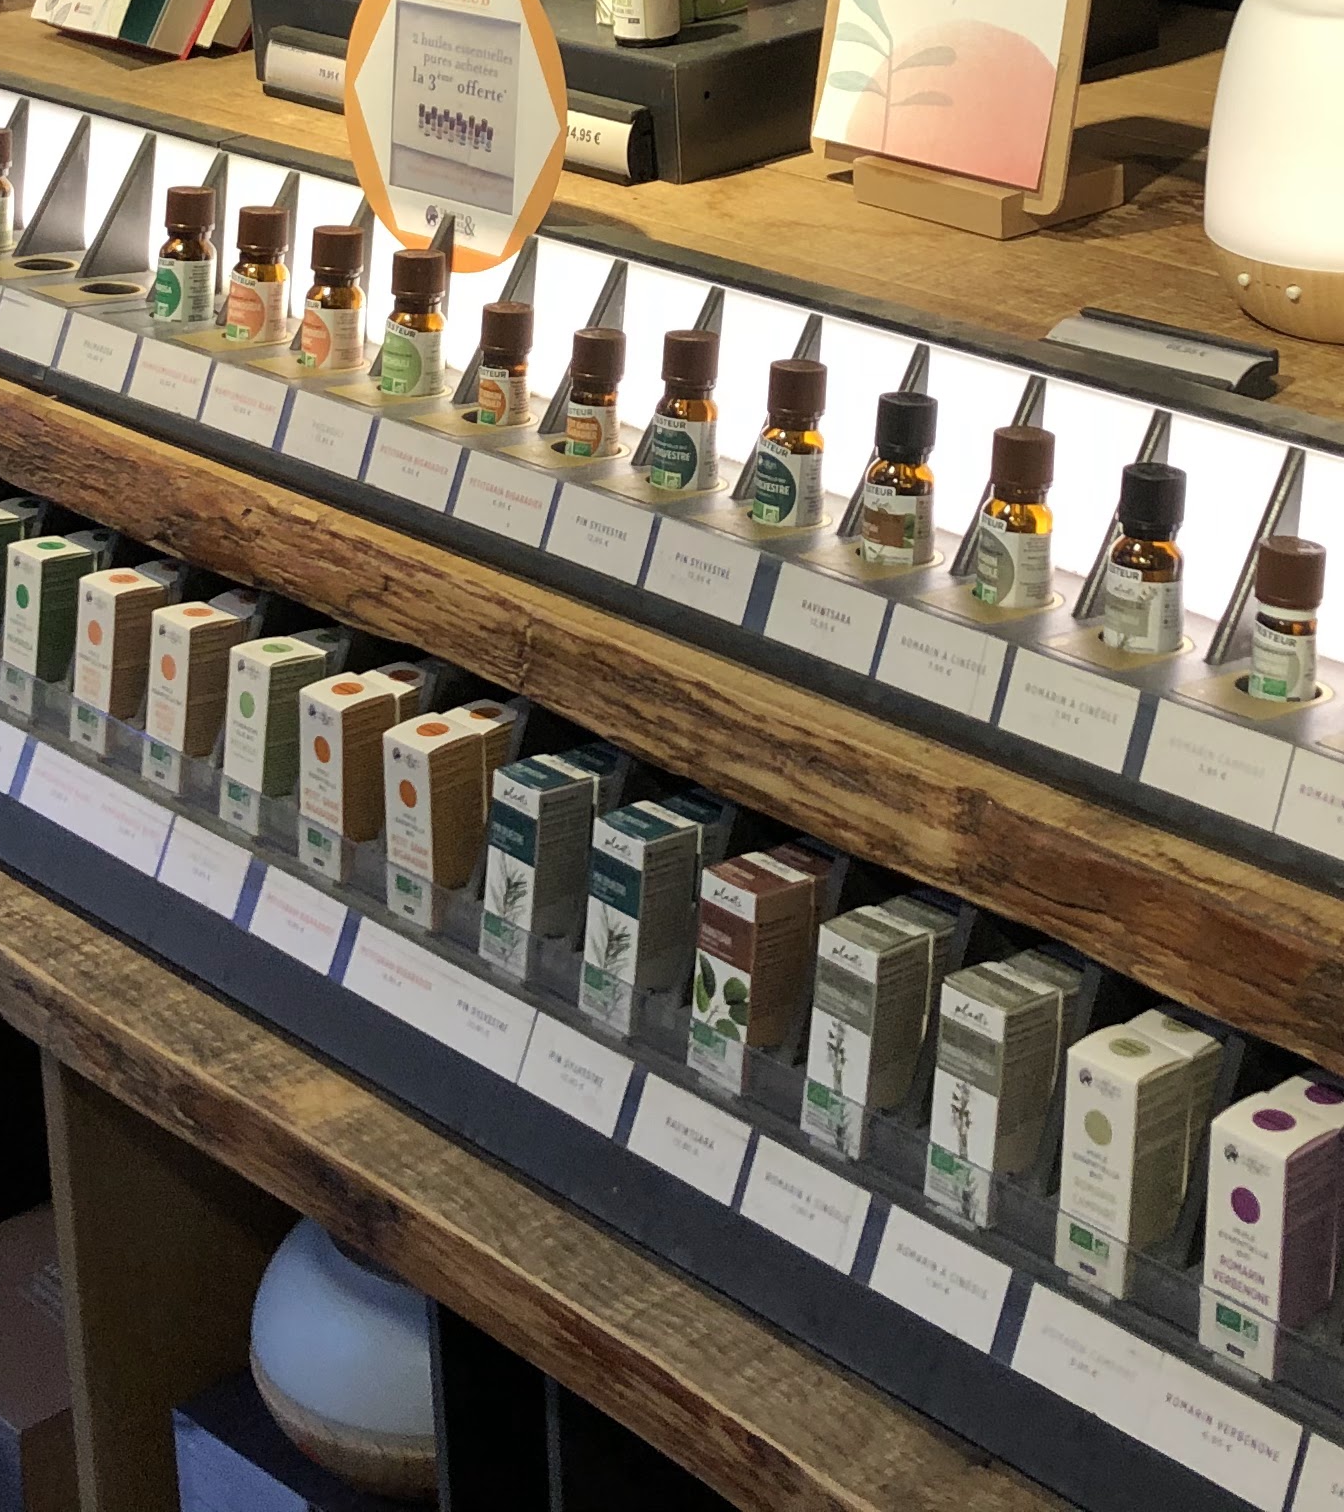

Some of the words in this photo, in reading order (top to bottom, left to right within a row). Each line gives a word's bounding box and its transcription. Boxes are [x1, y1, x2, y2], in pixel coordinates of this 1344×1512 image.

[413, 33, 418, 44] 2
[421, 32, 452, 52] huiles
[455, 42, 513, 66] essentielles
[423, 52, 452, 70] pures
[413, 66, 424, 84] la
[594, 132, 601, 145] €
[416, 470, 420, 478] €
[507, 503, 512, 511] €
[576, 515, 588, 527] PIN
[589, 519, 627, 541] SYLVESTRE
[604, 540, 609, 548] €
[675, 552, 689, 565] PIN
[690, 555, 730, 580] SYLVESTRE
[705, 577, 711, 586] €
[801, 599, 851, 625] RAVINTSARA
[900, 635, 939, 658] ROMARIN
[1024, 682, 1067, 706] ROMARIN
[1078, 698, 1118, 727] CINÉOLE
[1074, 715, 1080, 725] €
[1220, 1254, 1265, 1285] ROMARIN
[1165, 1392, 1213, 1426] ROMARIN
[1217, 1421, 1280, 1463] VERBENONE
[1226, 1443, 1233, 1453] €
